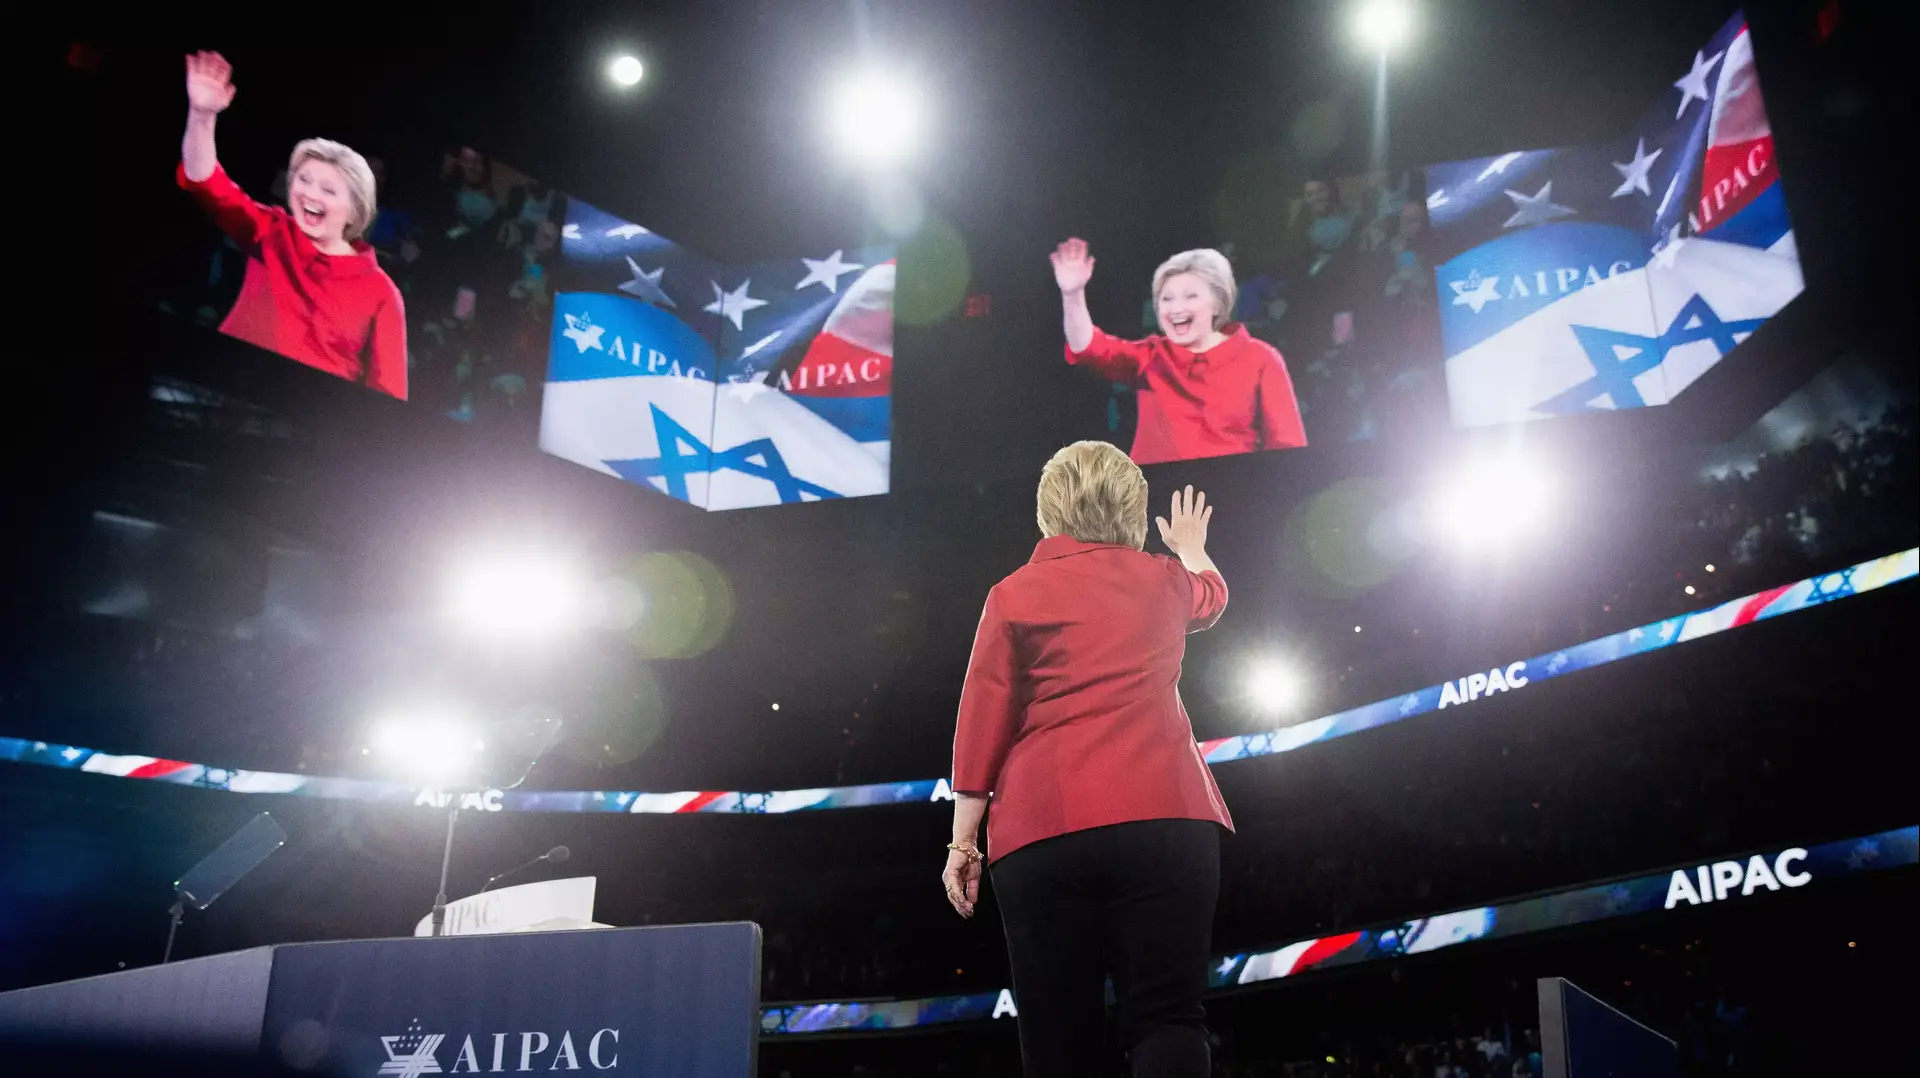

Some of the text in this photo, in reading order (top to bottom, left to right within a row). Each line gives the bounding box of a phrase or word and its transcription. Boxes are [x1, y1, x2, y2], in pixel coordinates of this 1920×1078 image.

[1687, 144, 1769, 236] AIPAC
[776, 358, 881, 392] AIPAC
[1438, 661, 1528, 709] AIPAC
[1664, 847, 1812, 909] AIPAC
[442, 894, 500, 935] IPAC
[450, 1028, 619, 1073] AIPAC
